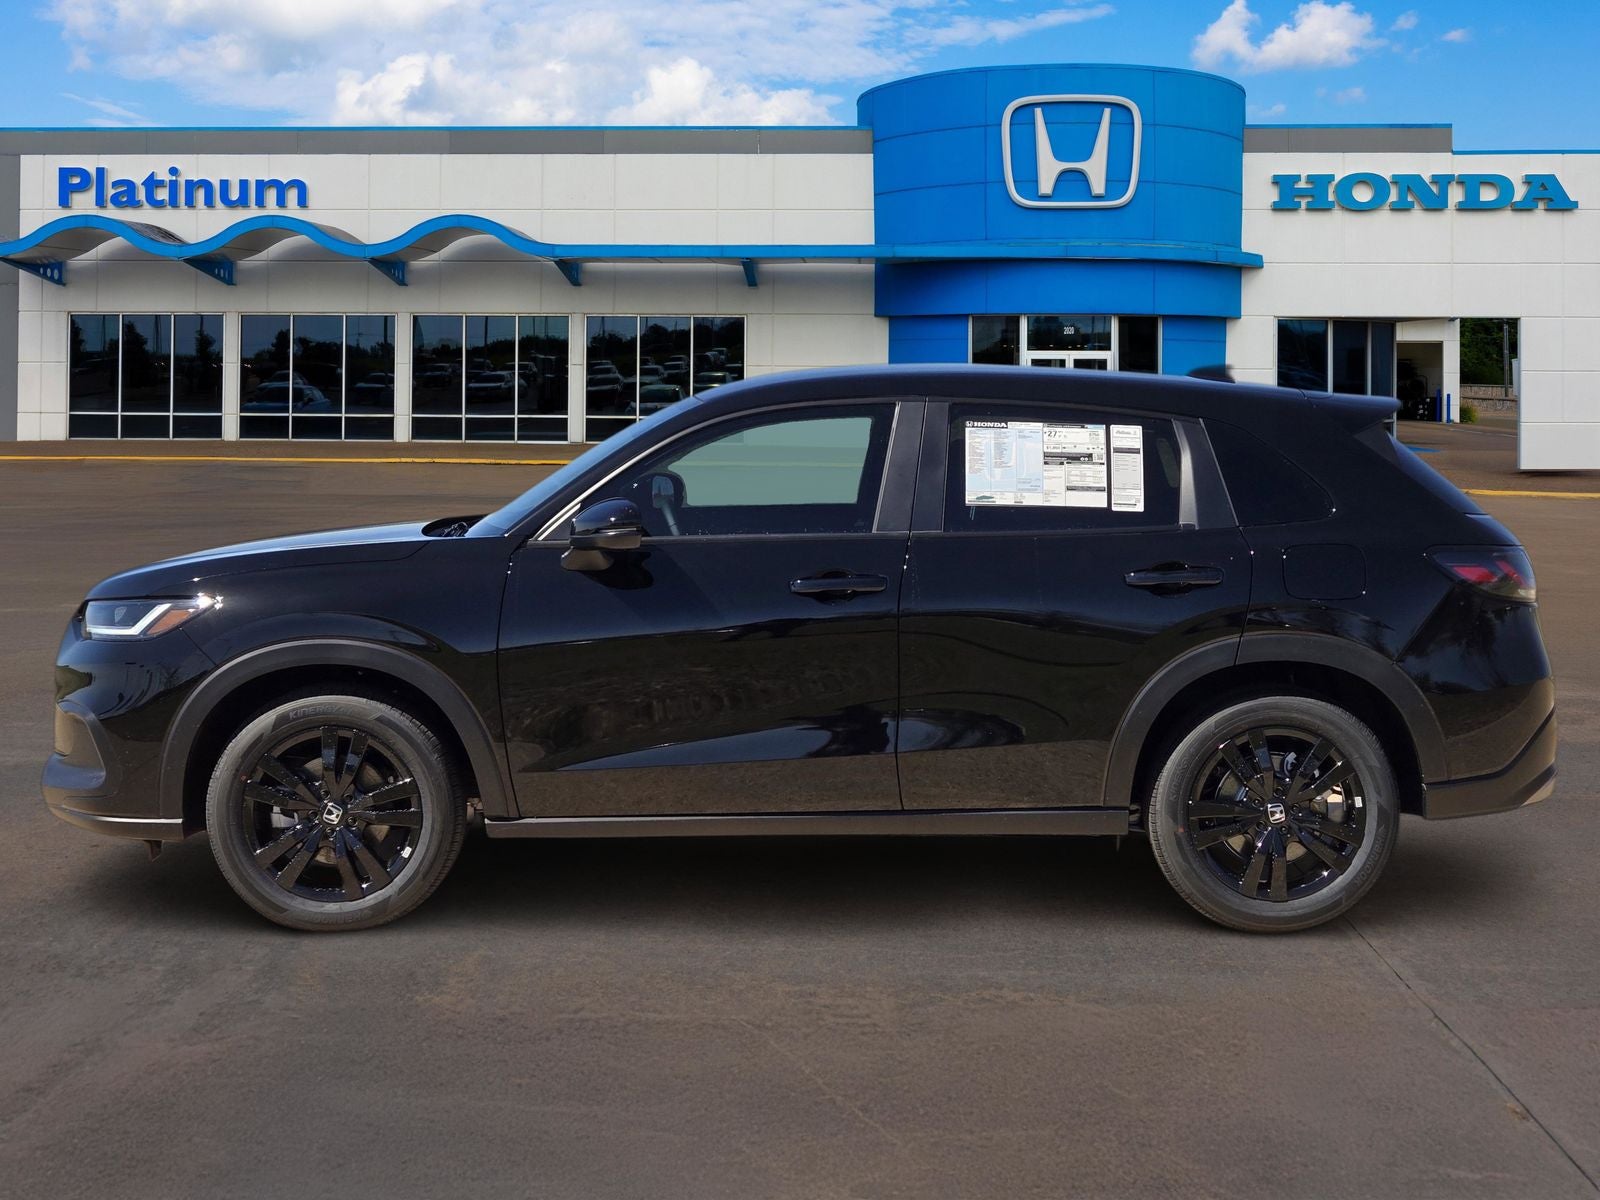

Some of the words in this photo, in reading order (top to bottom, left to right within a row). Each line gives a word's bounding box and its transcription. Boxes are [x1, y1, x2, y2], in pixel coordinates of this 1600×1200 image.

[57, 166, 309, 208] Platinum
[1270, 171, 1579, 212] HONDA
[1047, 430, 1058, 438] 27
